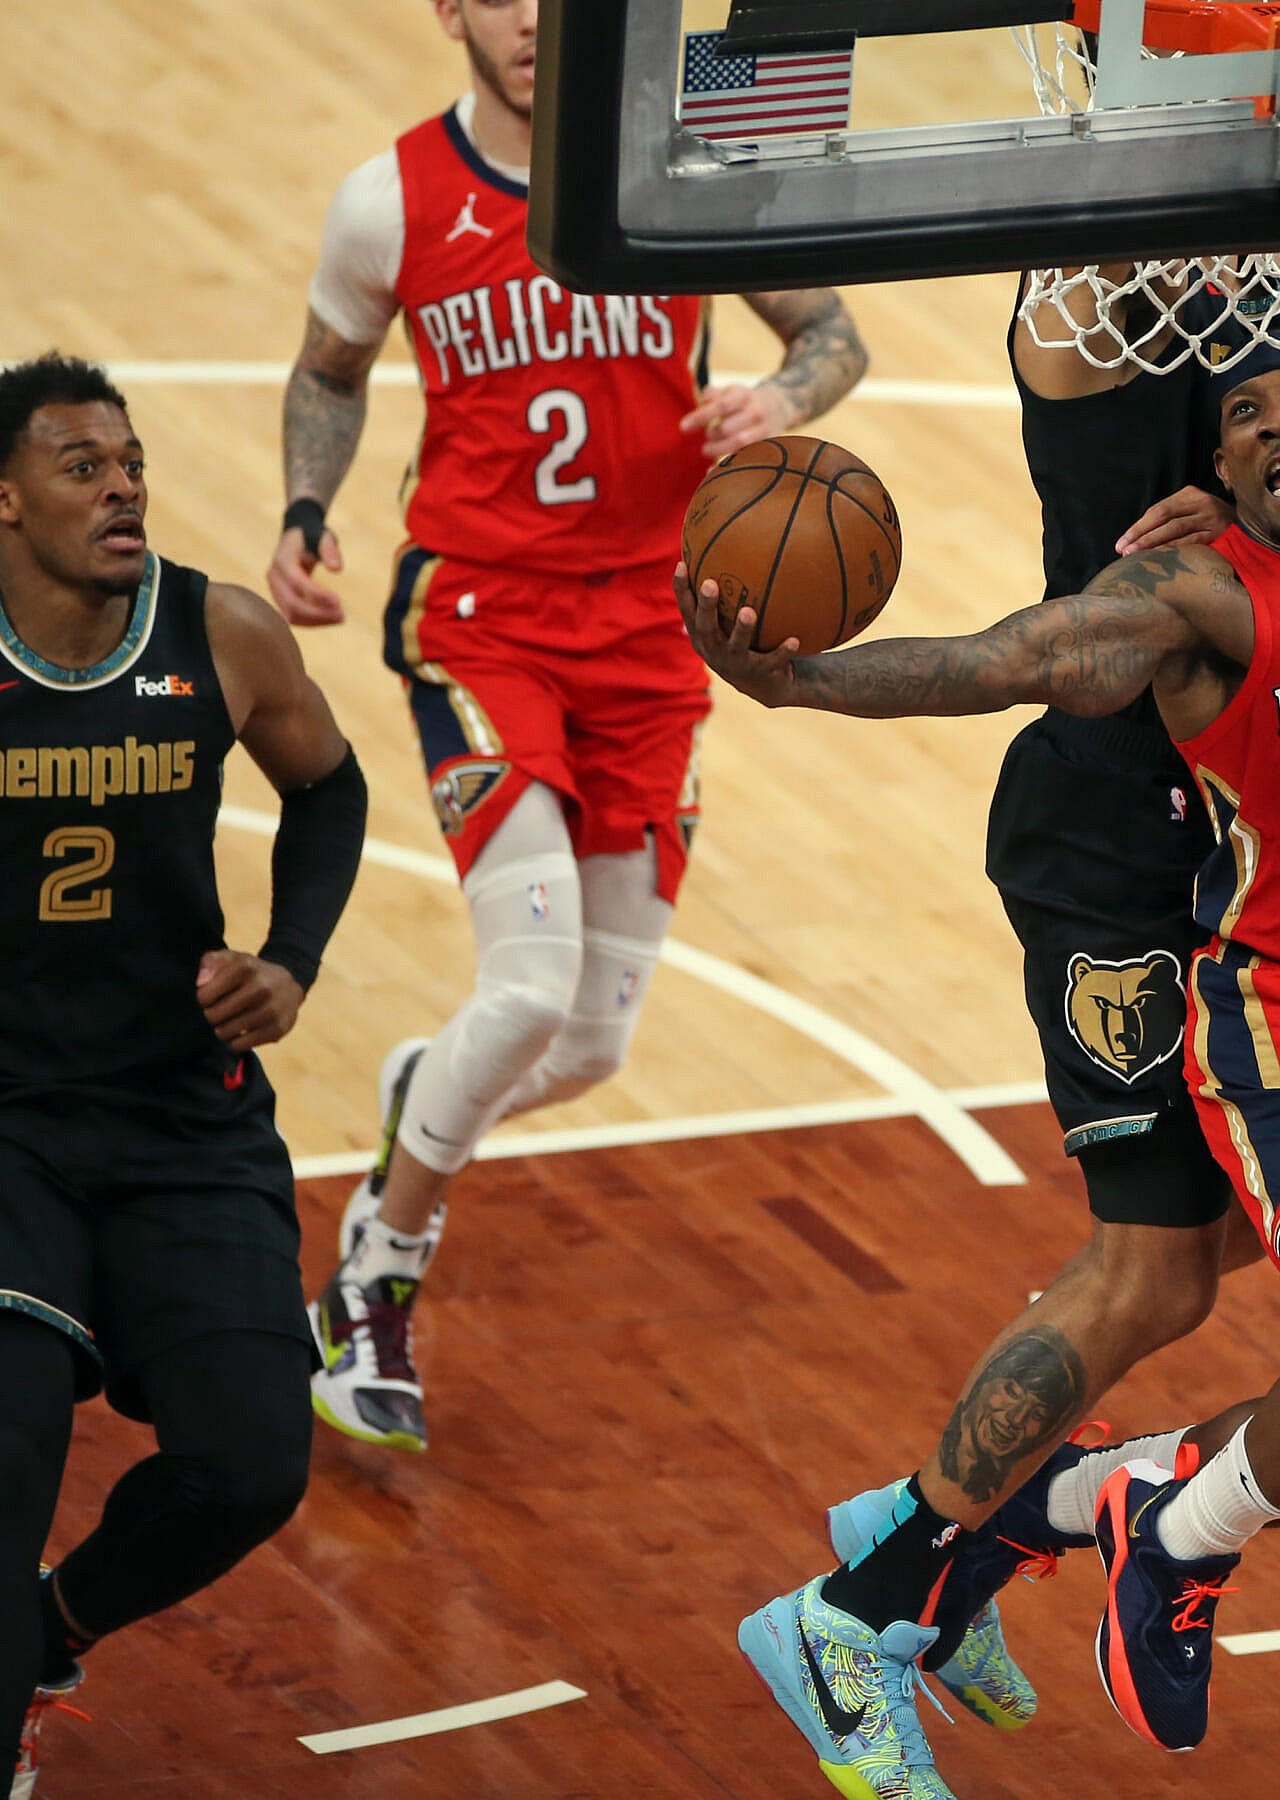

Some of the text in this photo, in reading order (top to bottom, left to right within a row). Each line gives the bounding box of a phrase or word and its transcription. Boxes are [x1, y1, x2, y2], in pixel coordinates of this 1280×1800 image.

[417, 273, 675, 388] PELICANS
[526, 388, 597, 506] 2
[135, 674, 195, 697] FedEx
[0, 735, 196, 806] emphis
[38, 825, 116, 923] 2
